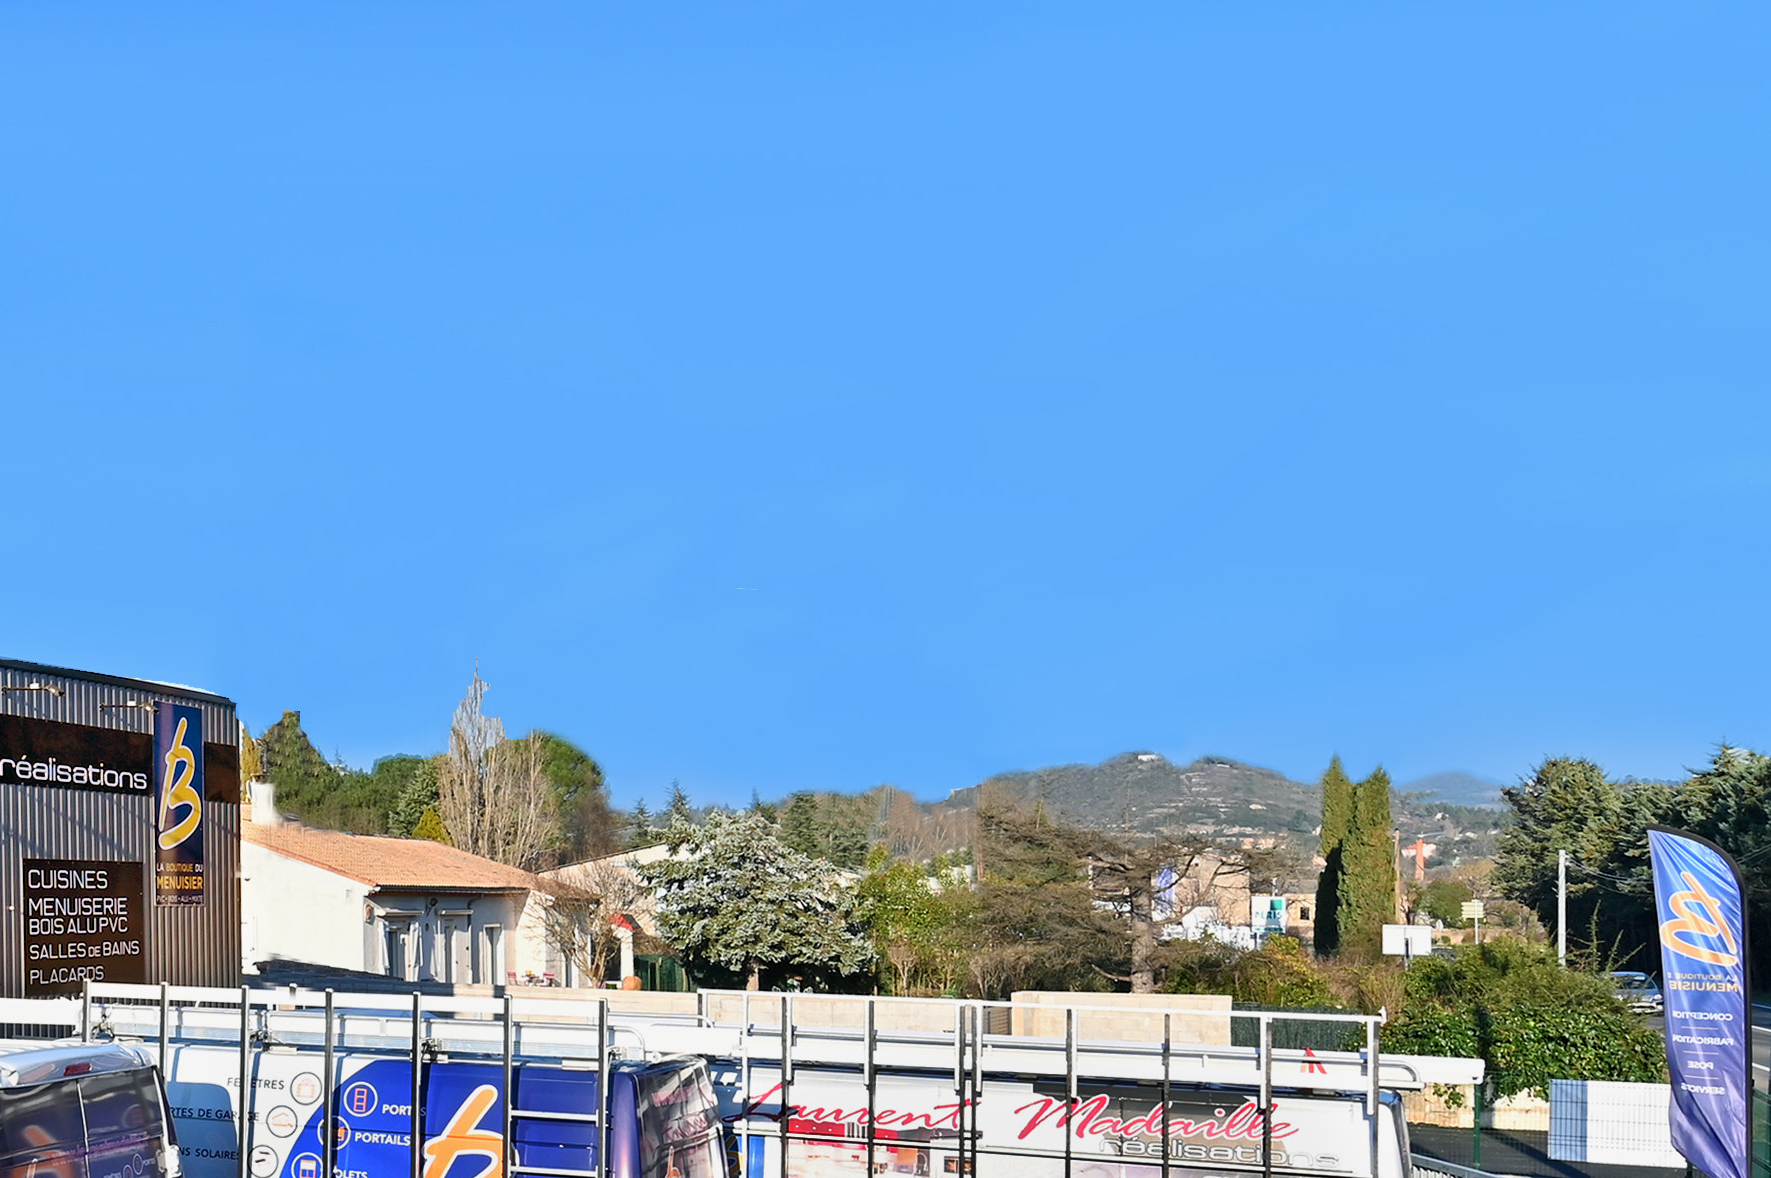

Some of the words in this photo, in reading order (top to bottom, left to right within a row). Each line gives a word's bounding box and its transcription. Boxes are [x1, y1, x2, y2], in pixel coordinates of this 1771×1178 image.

[0, 755, 147, 790] réalisations
[157, 863, 165, 872] LA
[166, 863, 193, 872] BOUTIQUE
[195, 864, 204, 872] DU
[28, 869, 108, 889] CUISINES
[157, 876, 204, 889] MENUISIER
[28, 897, 127, 916] MENUISERIE
[29, 917, 65, 935] BOIS
[67, 917, 97, 934] ALU
[99, 916, 128, 933] PVC
[30, 943, 86, 960] SALLES
[103, 940, 140, 956] BAINS
[30, 966, 104, 985] PLACARDS
[228, 1077, 285, 1091] FEETRES
[197, 1108, 213, 1119] DE
[382, 1104, 427, 1117] PORTS
[722, 1082, 981, 1129] Laurent
[1014, 1093, 1299, 1141] Madaille
[354, 1132, 411, 1147] PORTAILS
[195, 1147, 241, 1161] SOLAIRES
[1098, 1137, 1339, 1168] réalisations
